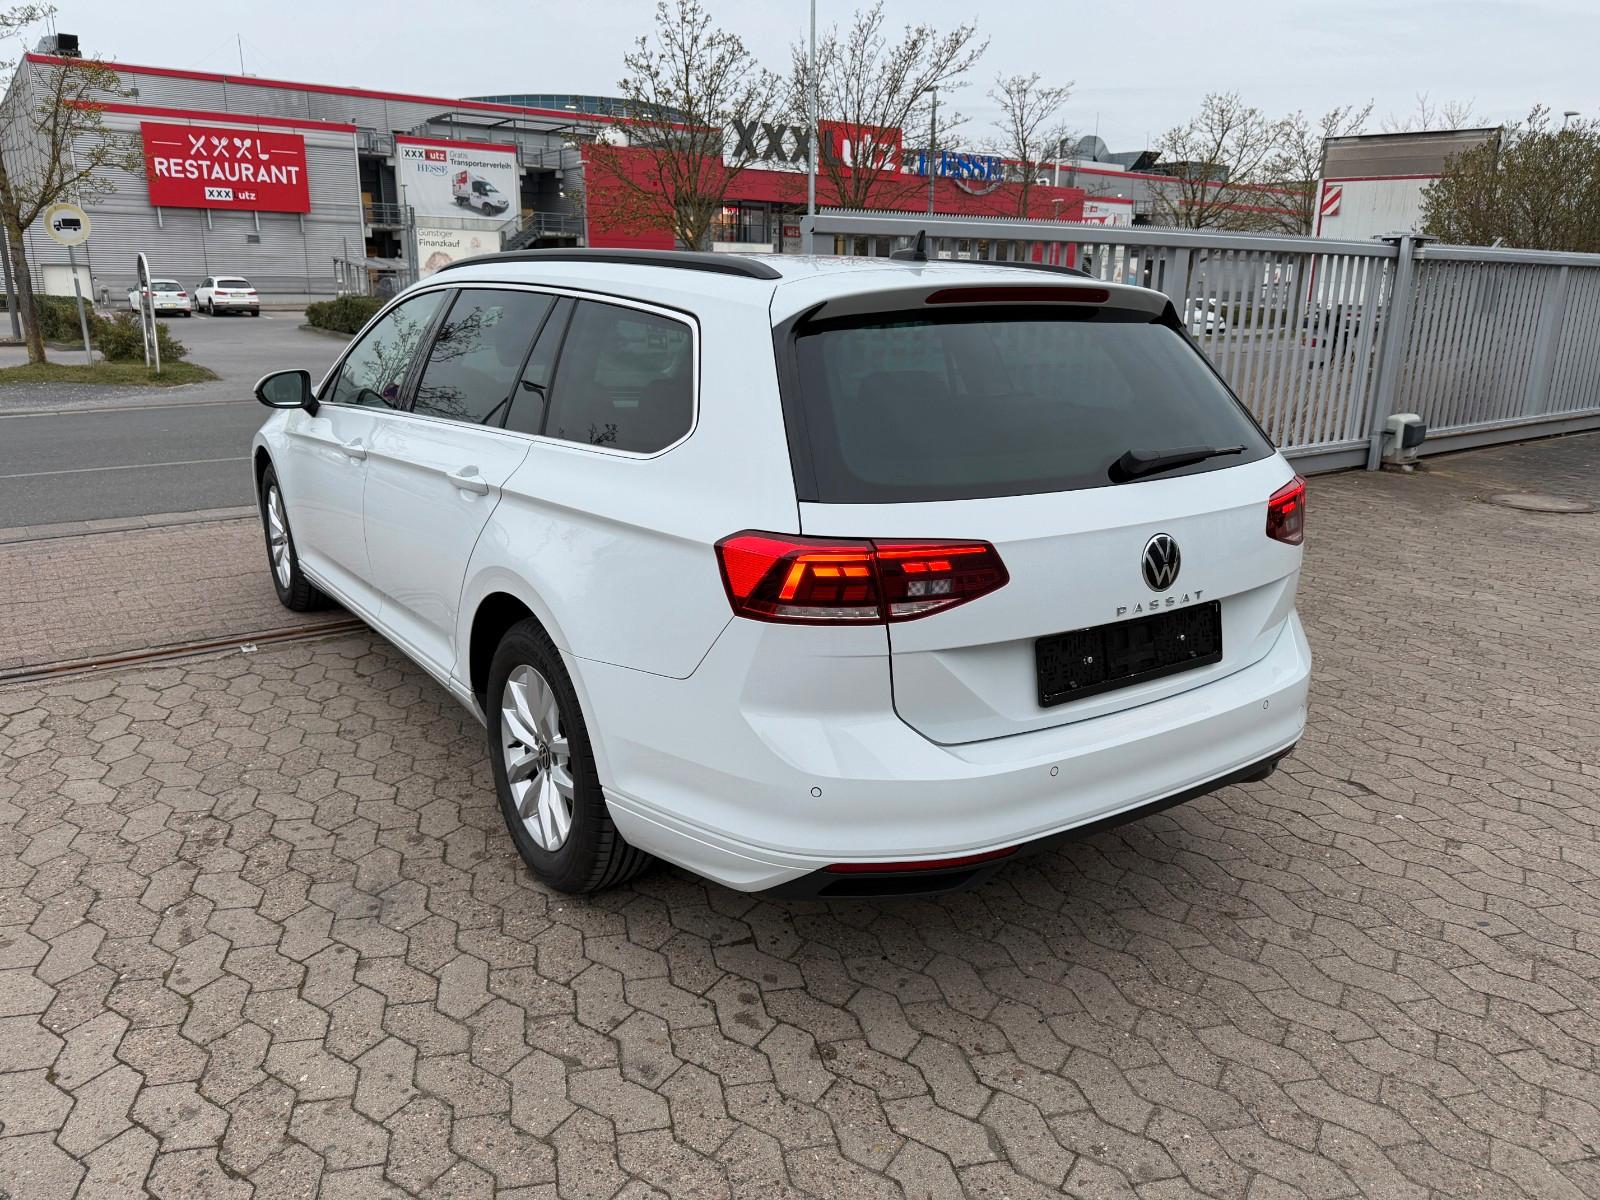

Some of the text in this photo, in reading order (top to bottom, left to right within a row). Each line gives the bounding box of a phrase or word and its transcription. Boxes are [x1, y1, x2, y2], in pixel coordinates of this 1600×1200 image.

[417, 163, 448, 174] HESSE
[450, 158, 512, 170] Transporterverleih
[154, 157, 300, 185] RESTAURANT
[419, 239, 460, 248] Finanzkauf
[1116, 590, 1204, 617] PASSAT
